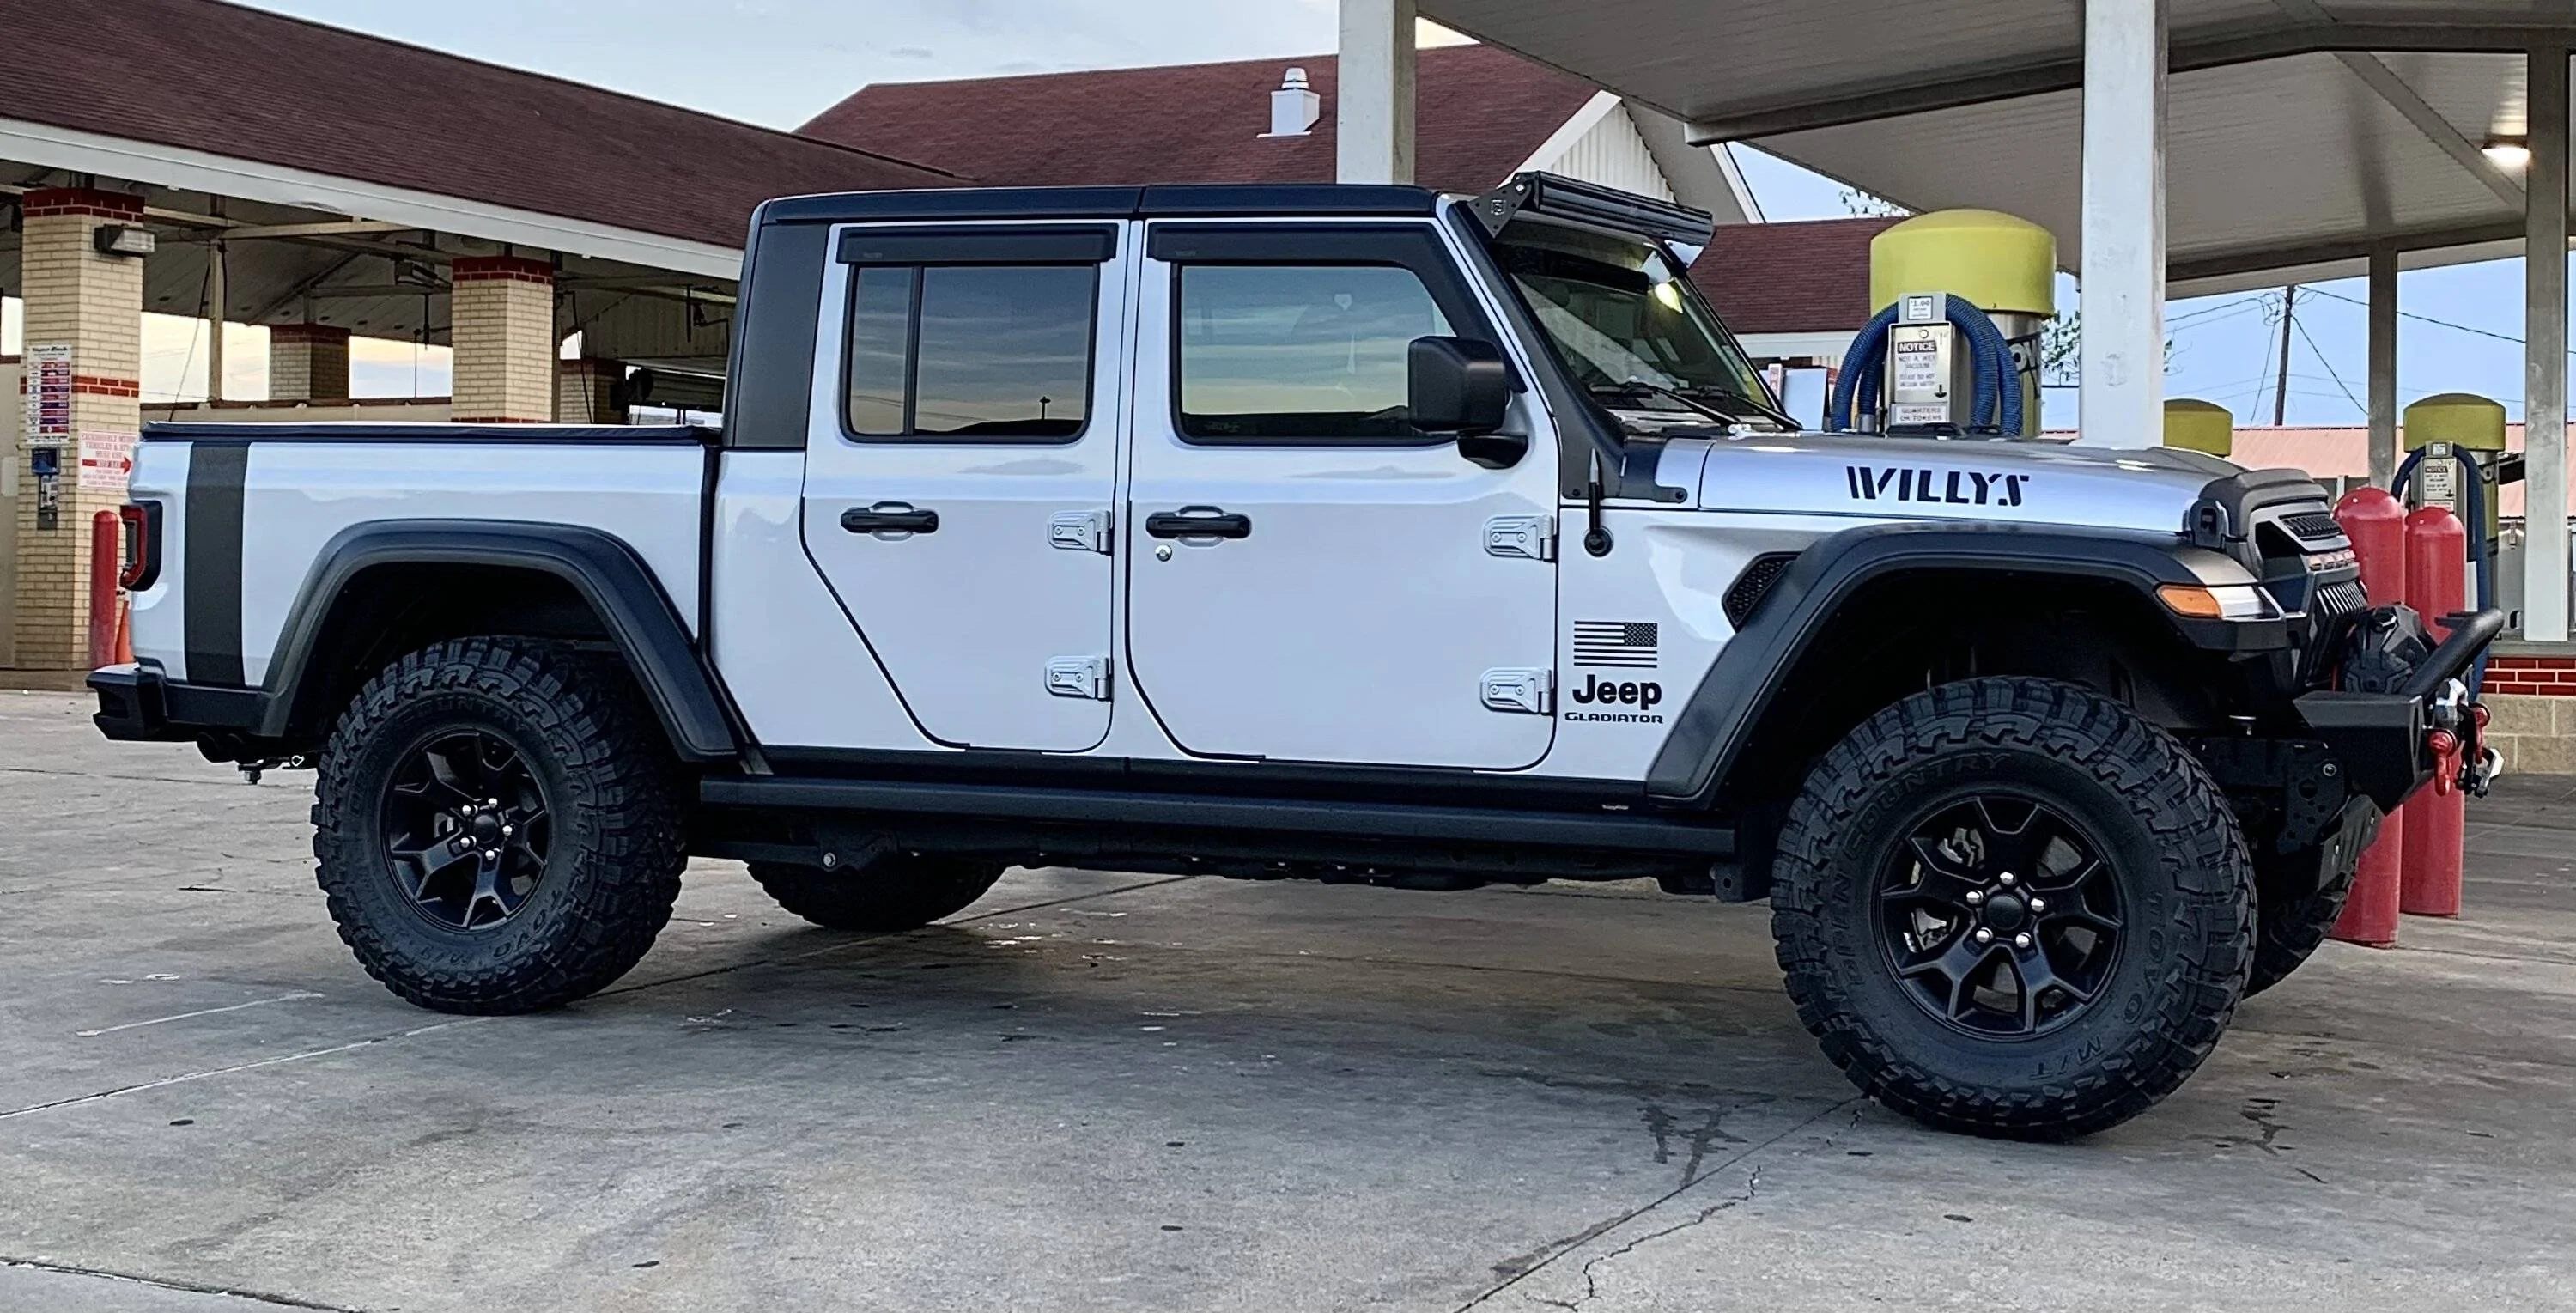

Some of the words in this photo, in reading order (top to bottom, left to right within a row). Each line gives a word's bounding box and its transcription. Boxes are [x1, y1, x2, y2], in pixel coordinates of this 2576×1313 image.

[1899, 342, 1935, 352] NOTICE
[1846, 466, 2030, 507] WILLYS
[1572, 674, 1662, 710] Jeep
[1564, 712, 1664, 724] GLADIATOR
[1842, 751, 2012, 862] COUNTRY
[2123, 890, 2166, 1025] TOYO
